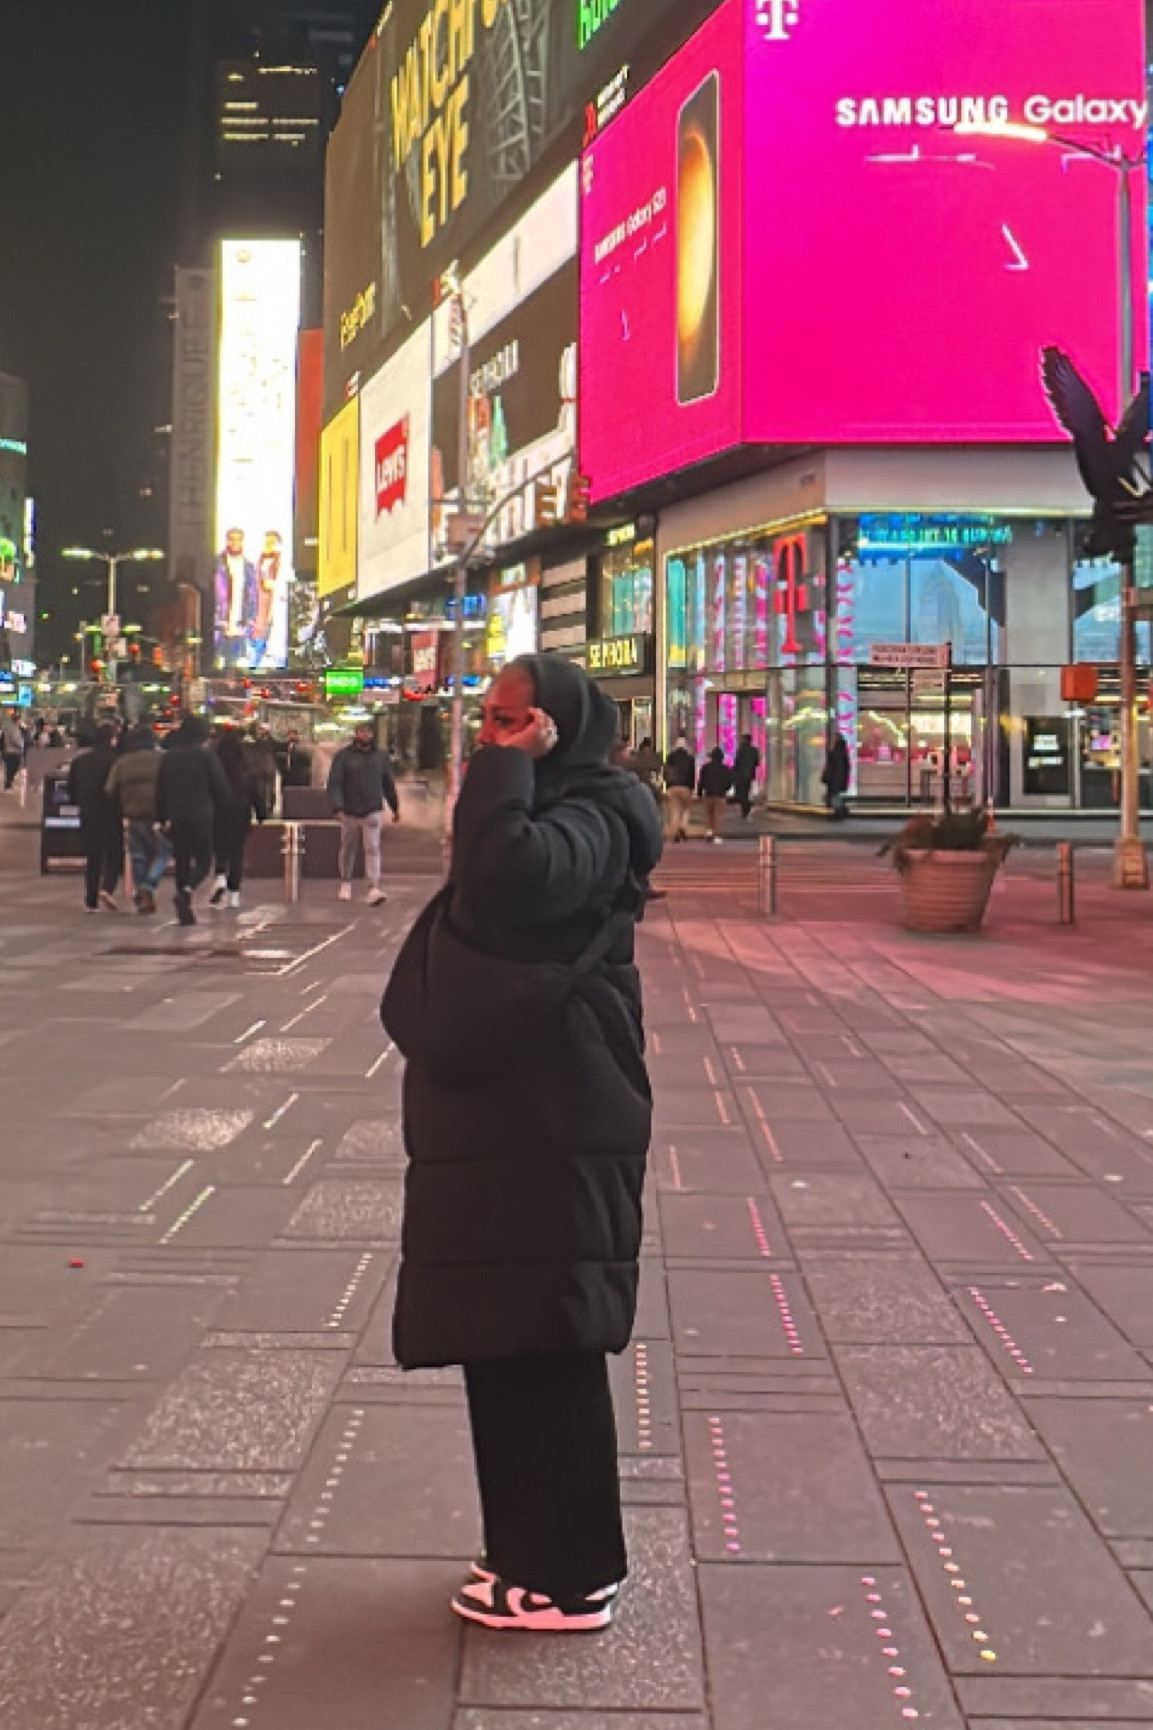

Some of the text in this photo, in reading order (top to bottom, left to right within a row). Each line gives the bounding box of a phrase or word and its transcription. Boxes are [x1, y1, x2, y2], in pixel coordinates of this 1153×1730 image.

[420, 73, 467, 249] EYE
[834, 94, 1148, 129] SAMSUNG Galaxy
[773, 533, 807, 653] T
